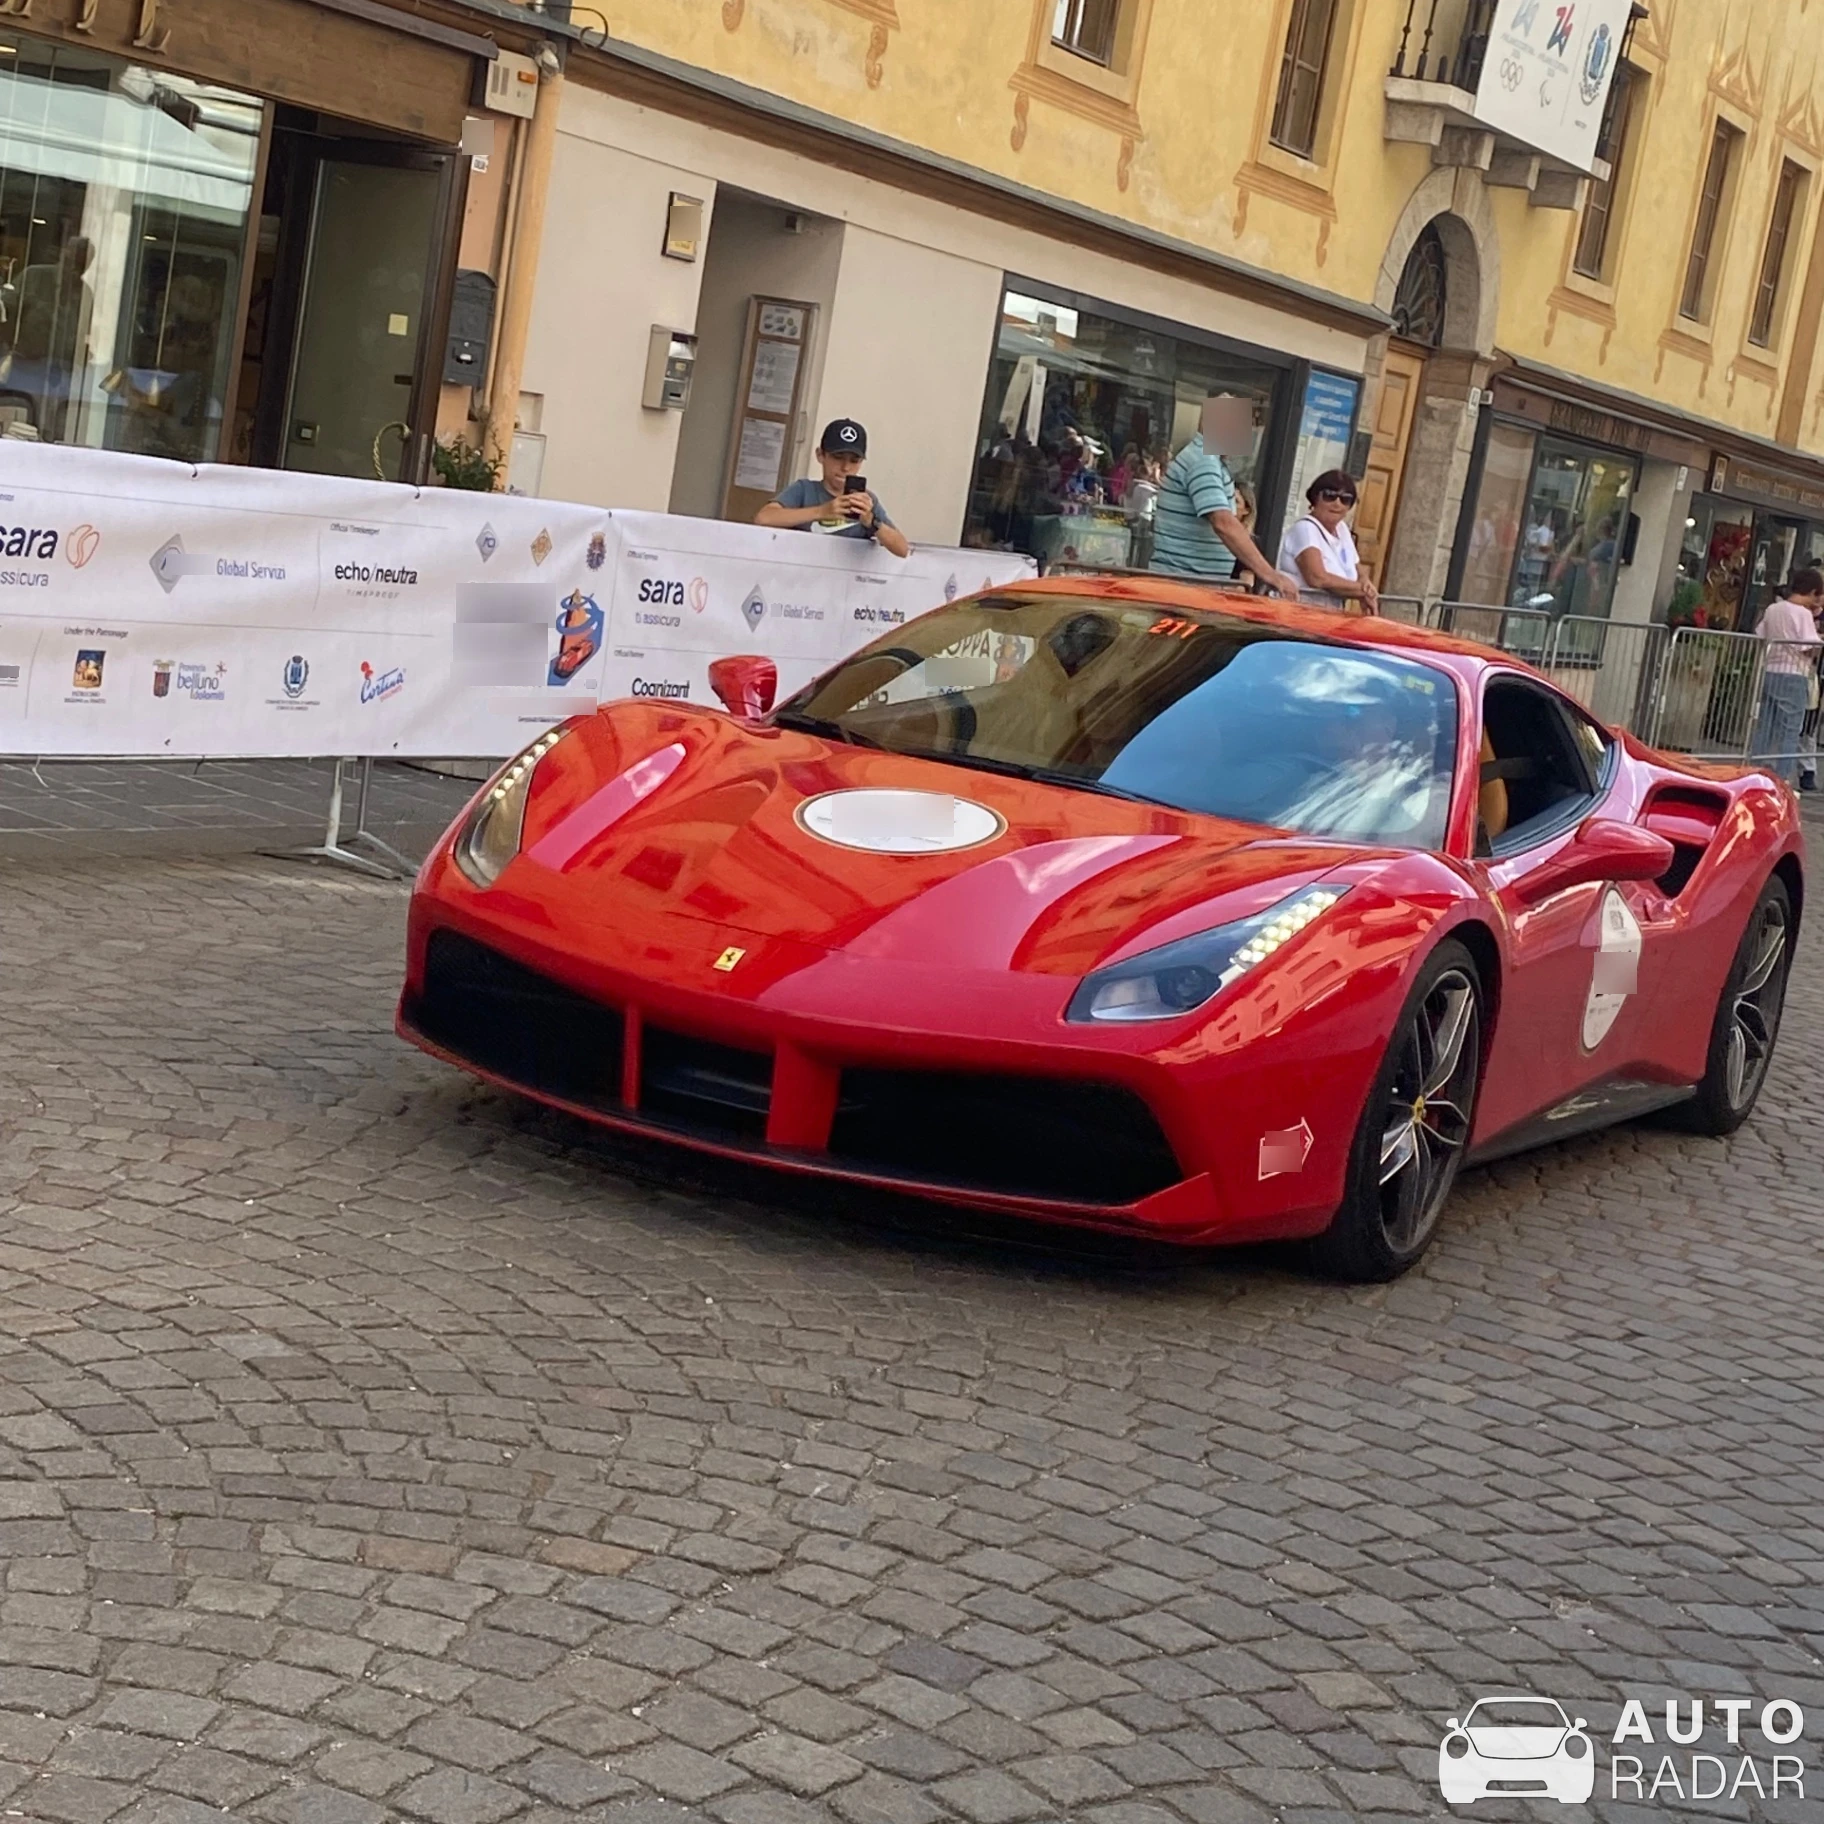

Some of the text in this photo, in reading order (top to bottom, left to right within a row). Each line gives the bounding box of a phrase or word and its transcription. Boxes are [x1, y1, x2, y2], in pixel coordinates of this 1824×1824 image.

[216, 558, 286, 580] Global Servizi
[638, 578, 684, 605] sara
[643, 614, 681, 628] assicura
[1149, 617, 1200, 640] 211
[176, 672, 219, 690] belluno
